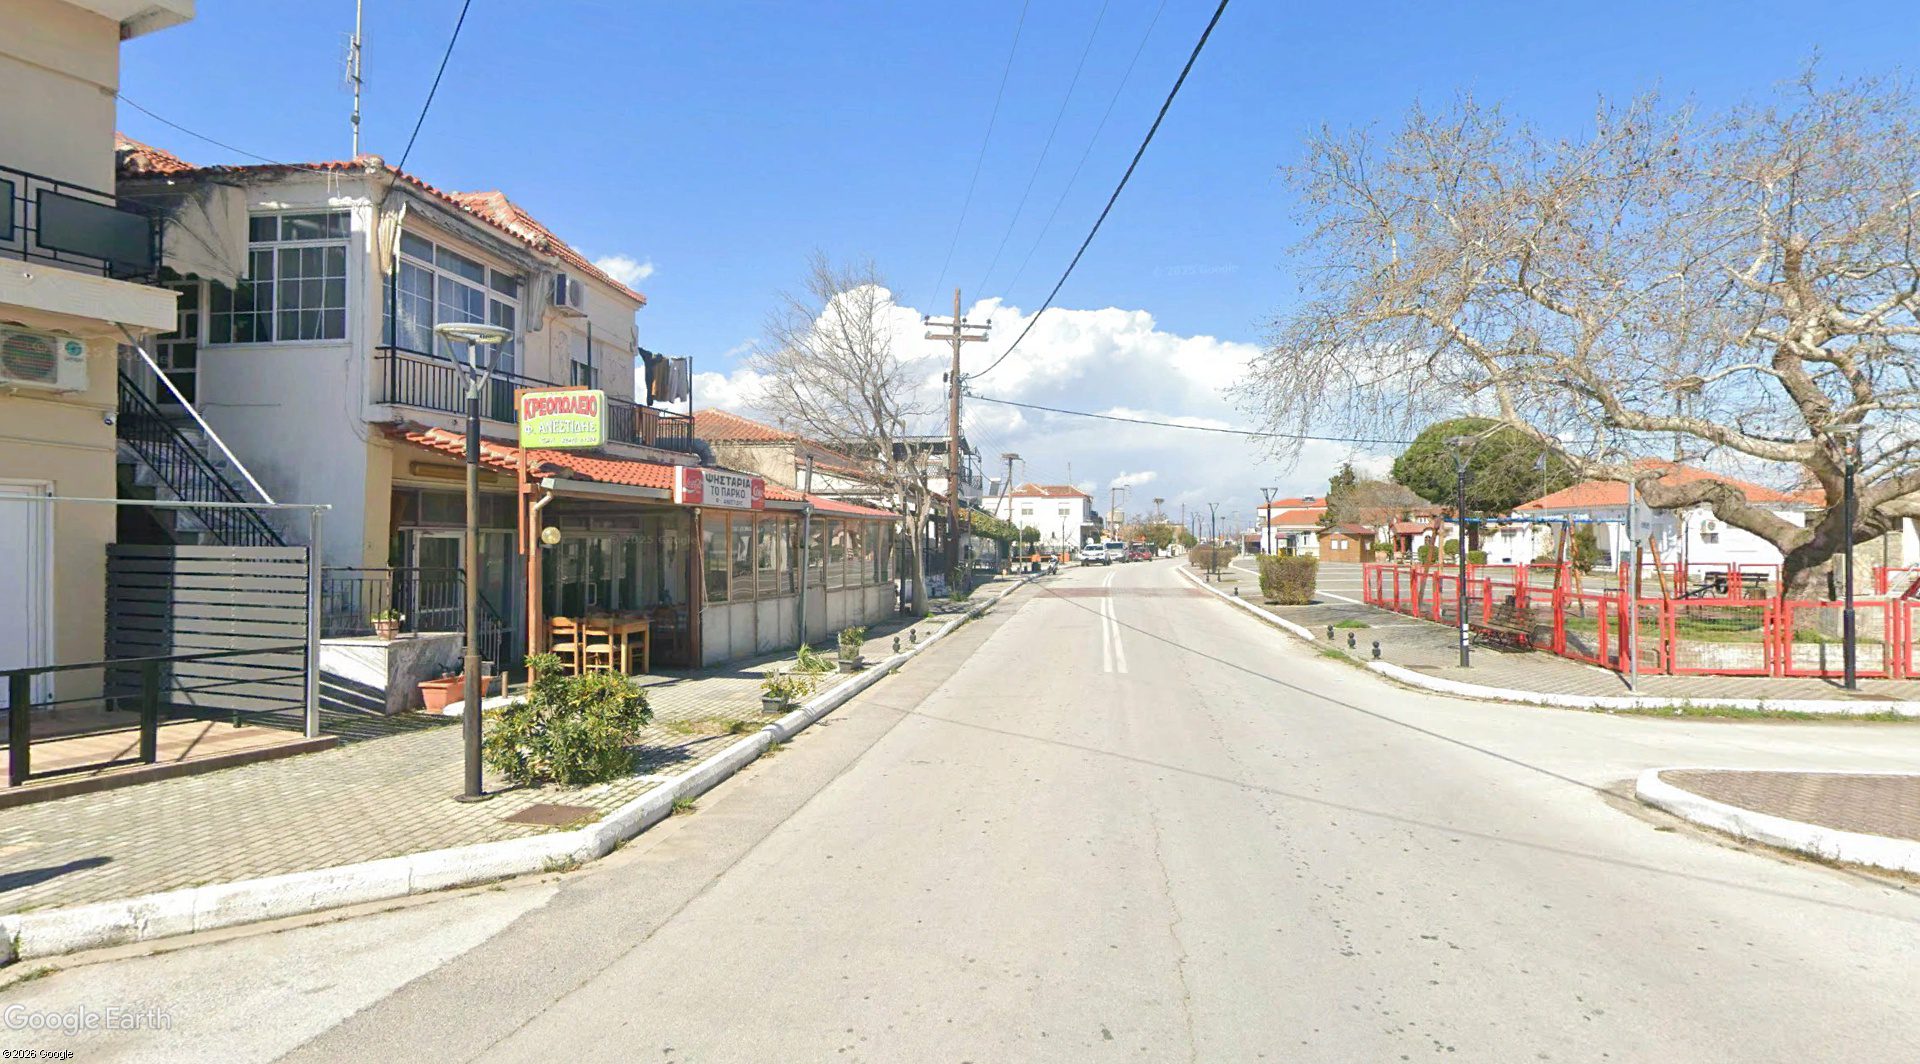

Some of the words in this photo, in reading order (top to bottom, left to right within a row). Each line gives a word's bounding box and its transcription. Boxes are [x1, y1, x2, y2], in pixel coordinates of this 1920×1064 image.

[524, 395, 597, 420] ΚΡΕΟΠΩΛΕΙΟ
[705, 473, 751, 489] ΨΗΣΤΑΡΙΑ
[711, 485, 720, 496] ΤΟ
[721, 486, 746, 499] ΠΑΡΚΟ
